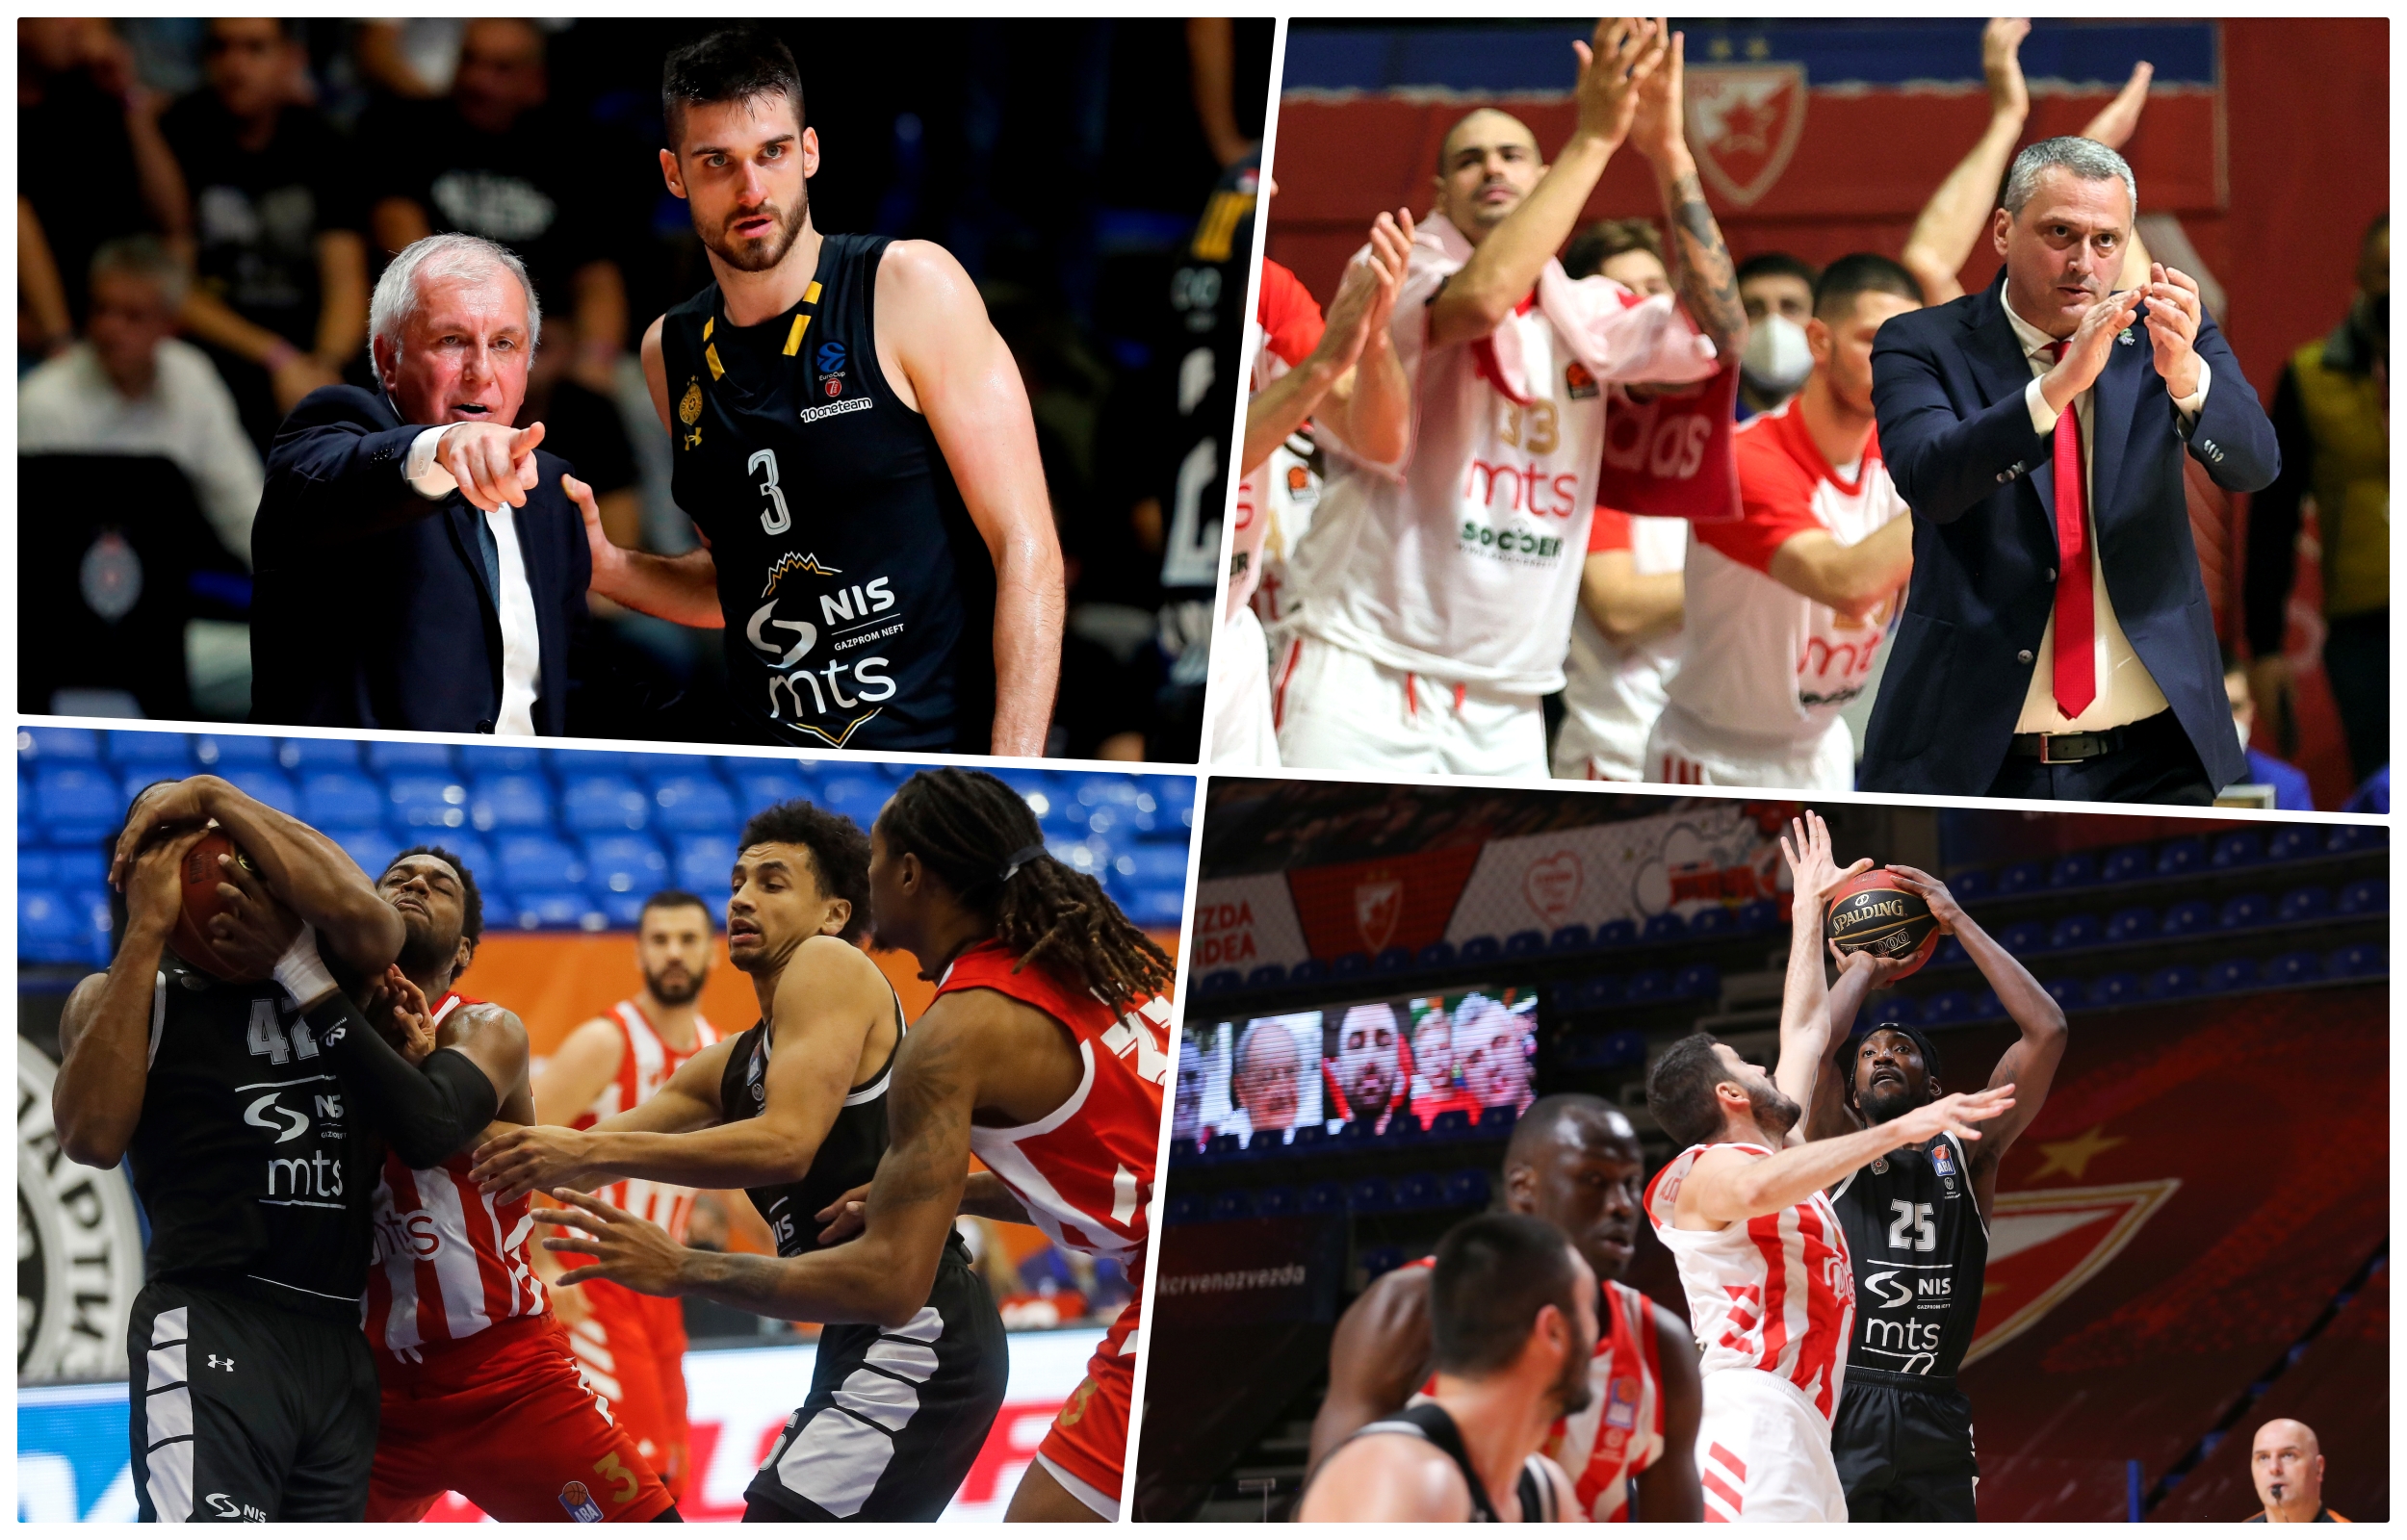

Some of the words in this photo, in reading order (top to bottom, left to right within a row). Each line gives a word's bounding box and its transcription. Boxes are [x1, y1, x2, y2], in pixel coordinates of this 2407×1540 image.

[818, 372, 845, 381] EuroCup
[748, 449, 791, 536] 3
[1464, 457, 1579, 519] mts
[819, 576, 895, 626] NIS
[834, 630, 881, 652] GAZPROM
[881, 623, 904, 637] NEFT
[769, 656, 896, 718] mts
[1832, 898, 1906, 936] SPALDING
[268, 1149, 344, 1196] mts
[1936, 1160, 1954, 1173] ABA
[1889, 1198, 1936, 1252] 25
[1918, 1277, 1952, 1296] NIS
[1865, 1316, 1941, 1351] mts
[592, 1450, 638, 1503] 3
[243, 1503, 267, 1523] NIS
